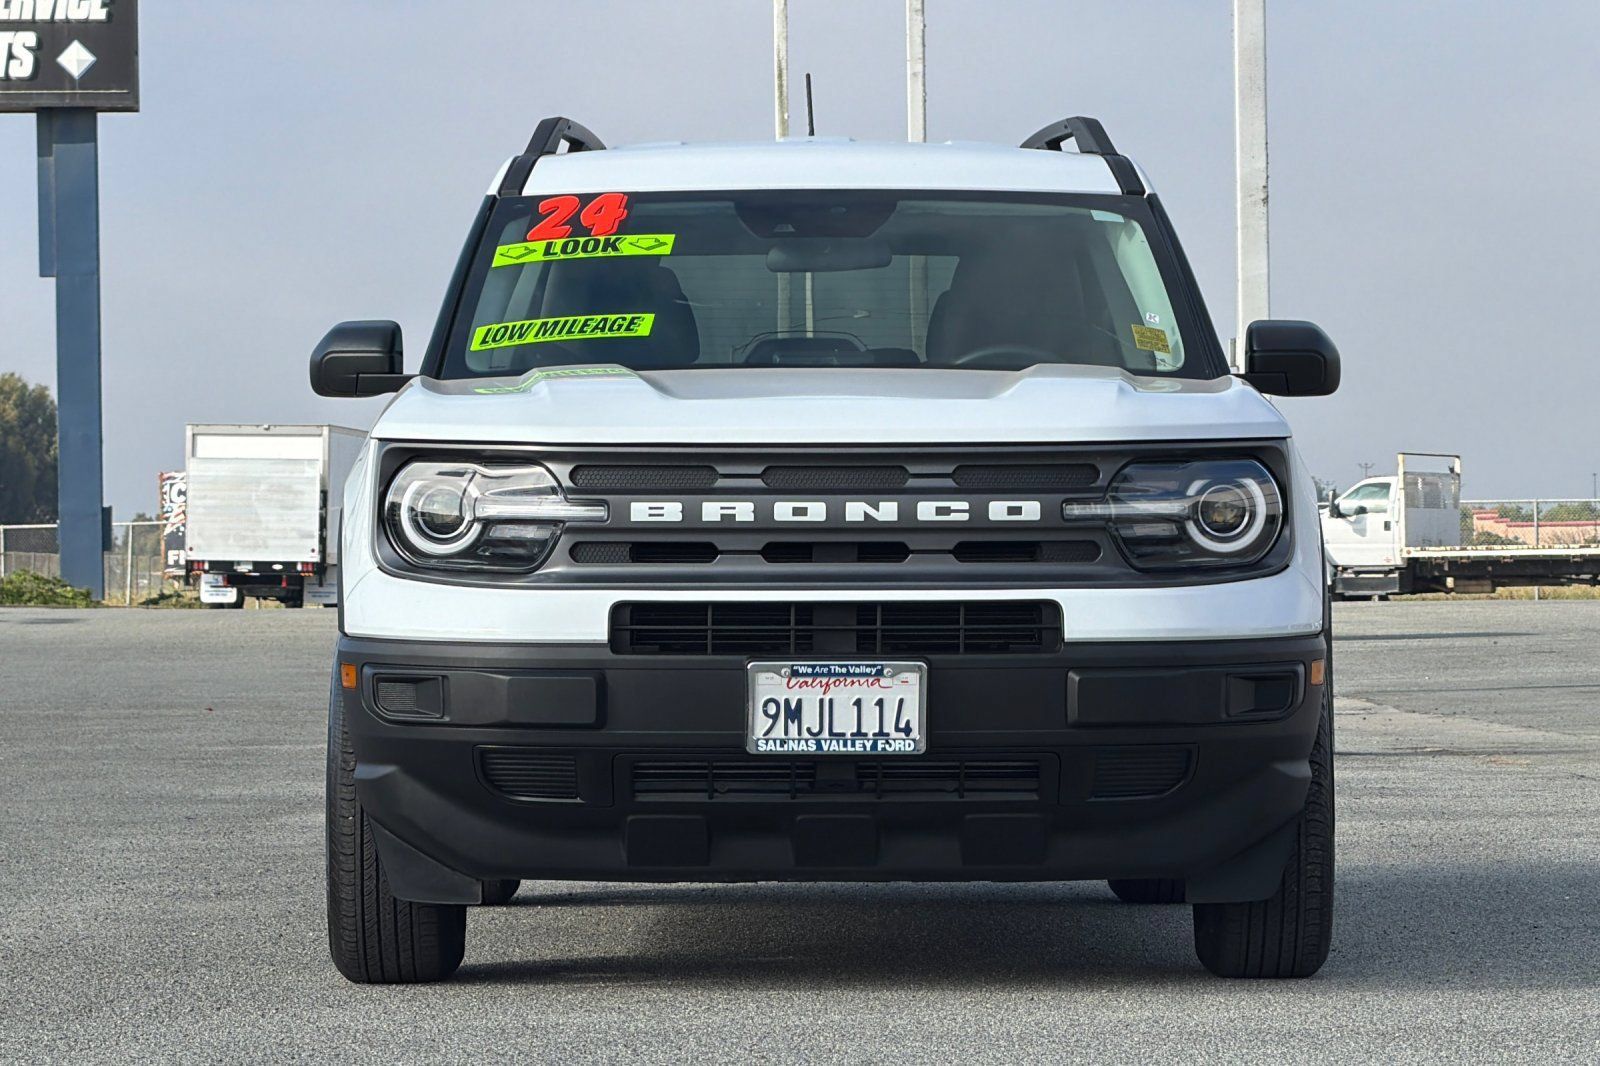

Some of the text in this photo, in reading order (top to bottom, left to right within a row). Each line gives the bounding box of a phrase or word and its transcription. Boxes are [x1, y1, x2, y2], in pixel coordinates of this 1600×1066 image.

[527, 193, 628, 241] 24
[542, 236, 625, 259] LOOK
[479, 316, 646, 347] LOW MILEAGE
[630, 501, 1041, 522] BRONCO
[814, 665, 828, 674] Are
[829, 665, 847, 674] The
[786, 676, 893, 696] California
[761, 697, 913, 738] 9MJL114
[757, 739, 915, 751] SALINAS VALLEY FORD
